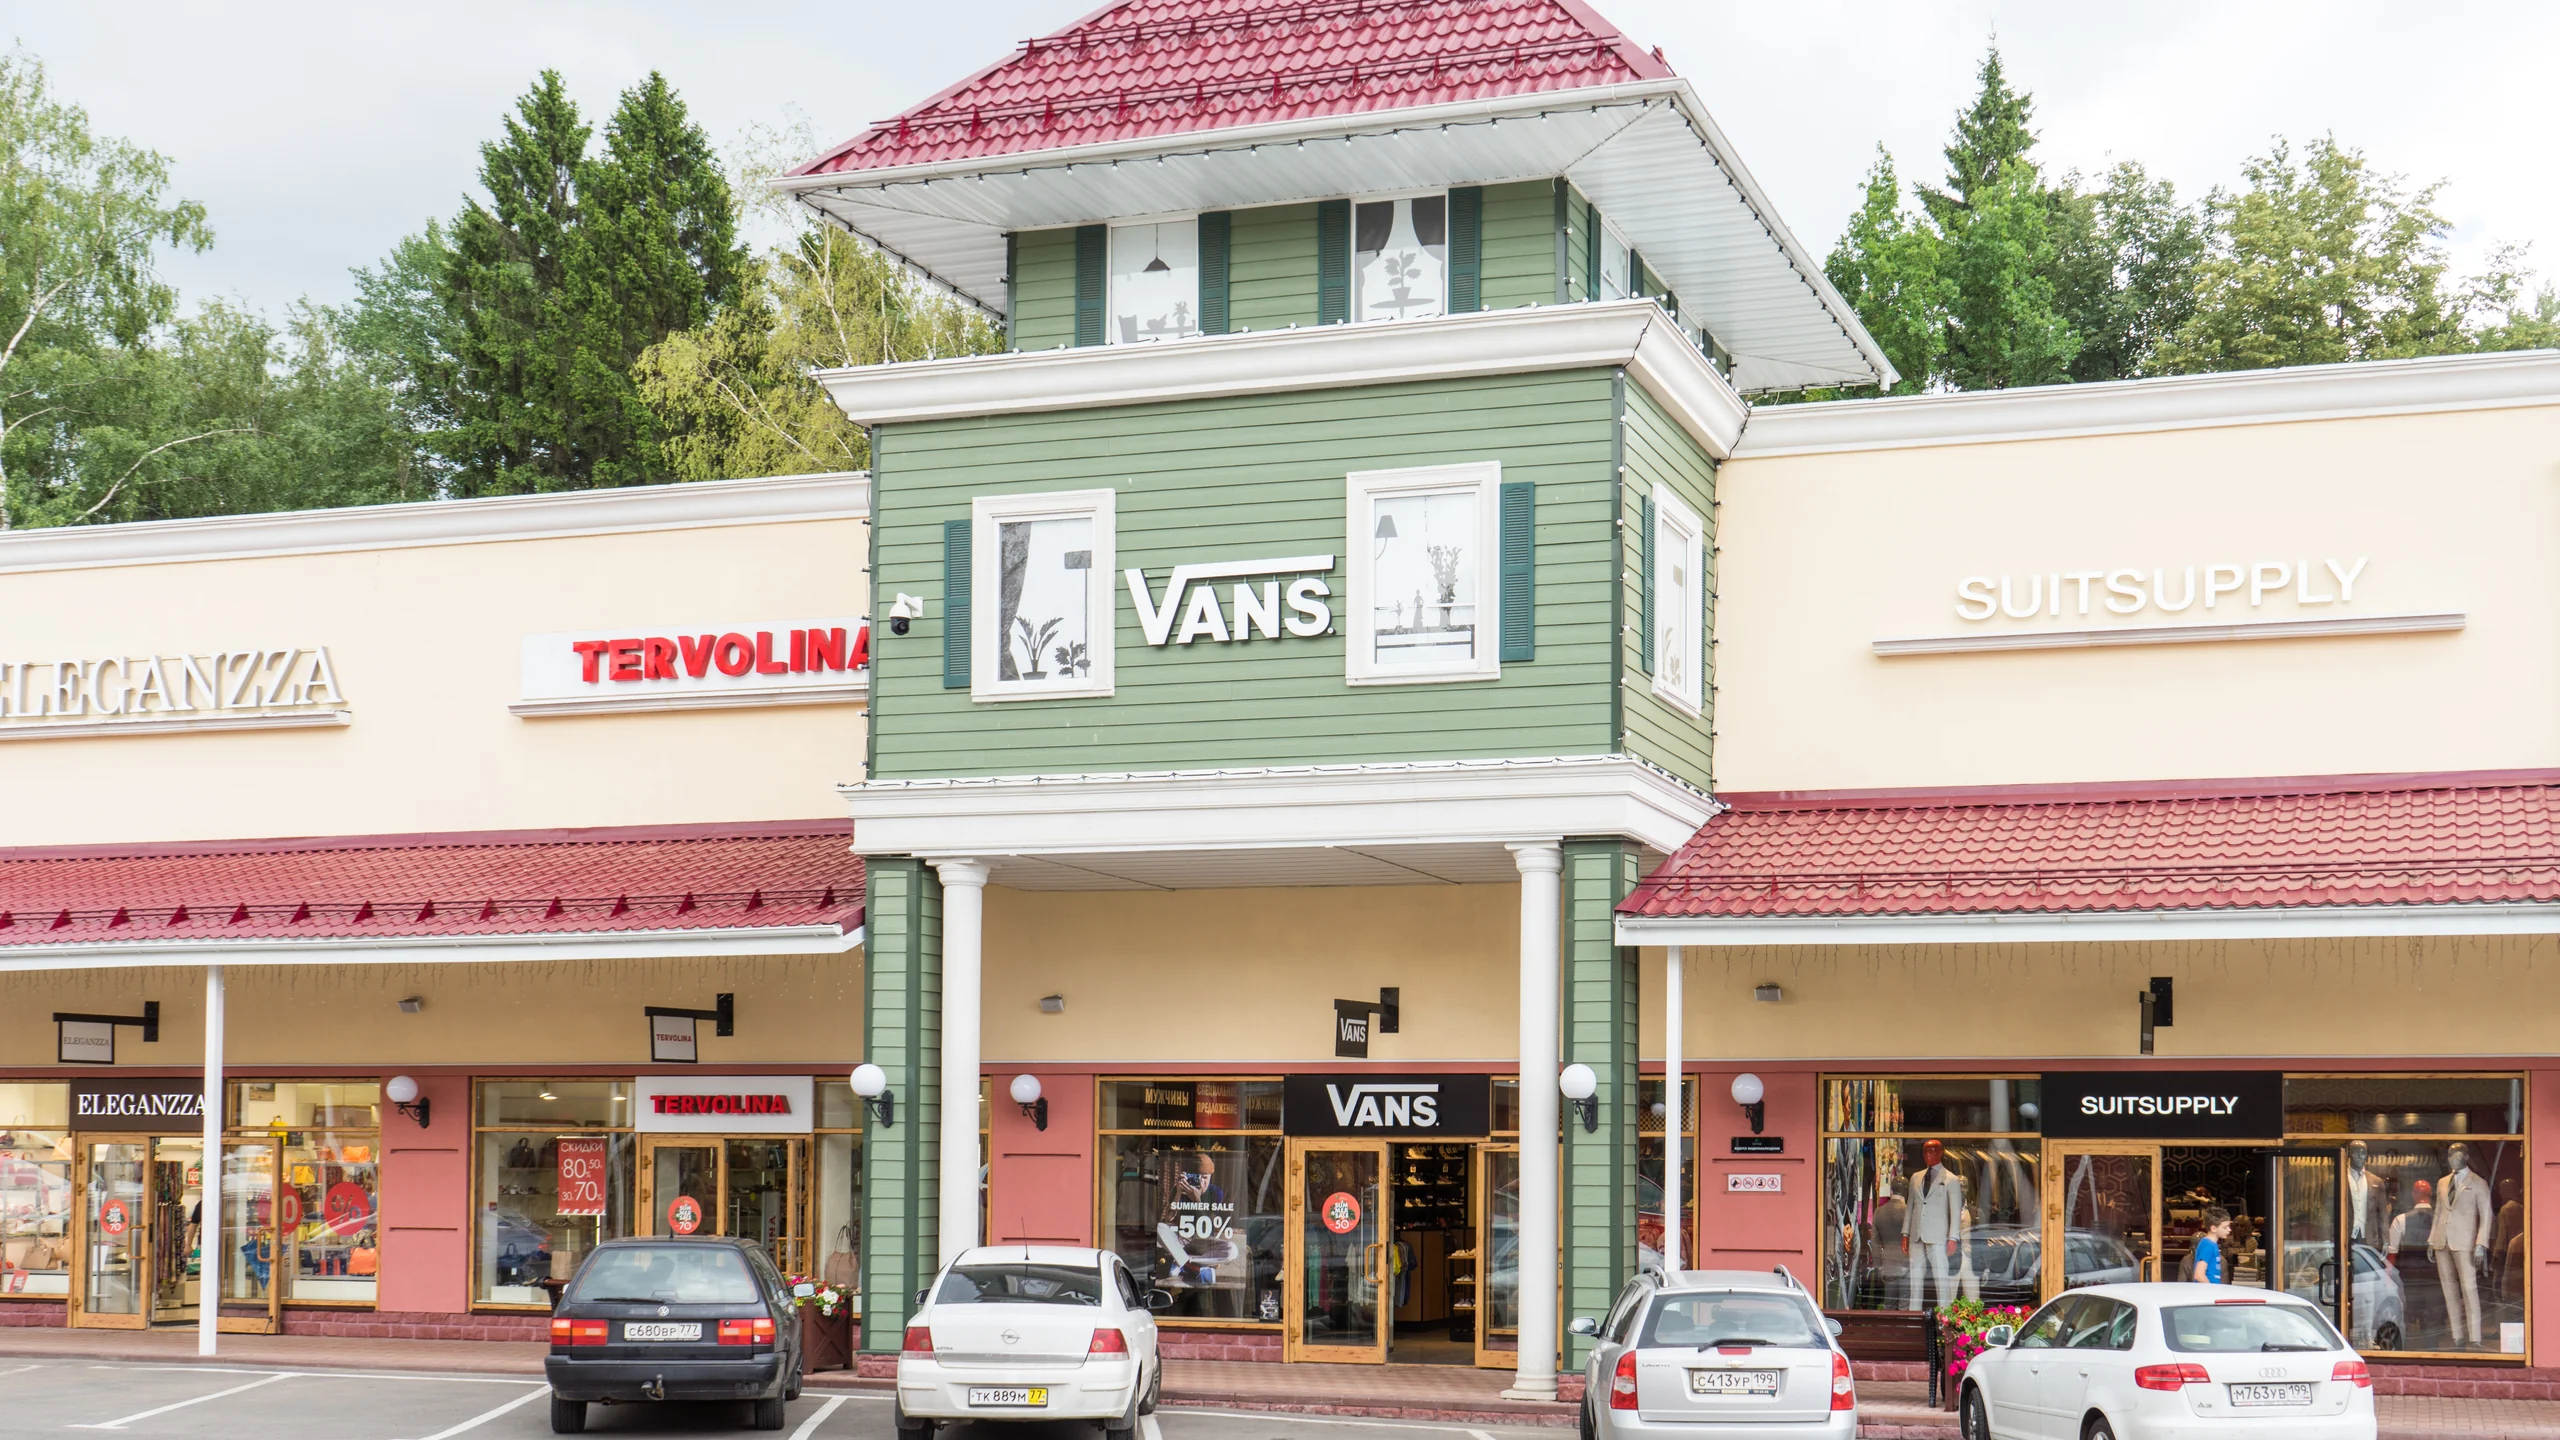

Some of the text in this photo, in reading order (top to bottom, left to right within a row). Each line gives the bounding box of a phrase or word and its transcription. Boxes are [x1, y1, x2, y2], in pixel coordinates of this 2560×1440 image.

[1955, 556, 2369, 620] SUITSUPPLY
[1124, 554, 1335, 645] VANS
[0, 646, 347, 718] LEGANZZA
[1340, 1018, 1367, 1043] VANS
[64, 1037, 110, 1047] ELEGANZZA
[656, 1034, 692, 1042] TERVOLINA
[1145, 1088, 1189, 1106] МУЖЧИНЫ
[77, 1094, 205, 1116] ELEGANZZA
[650, 1095, 791, 1114] TERVOLINA
[1326, 1084, 1440, 1127] VANS
[2081, 1096, 2238, 1115] SUITSUPPLY
[561, 1142, 603, 1153] СКИДКИ
[1170, 1202, 1234, 1211] SUMMER SALE
[679, 1221, 692, 1231] 70
[1169, 1215, 1233, 1239] -50%
[1335, 1219, 1350, 1229] 50
[680, 1324, 698, 1333] 777
[1753, 1374, 1773, 1384] 199
[1030, 1390, 1042, 1399] 77
[2288, 1385, 2307, 1395] 199
